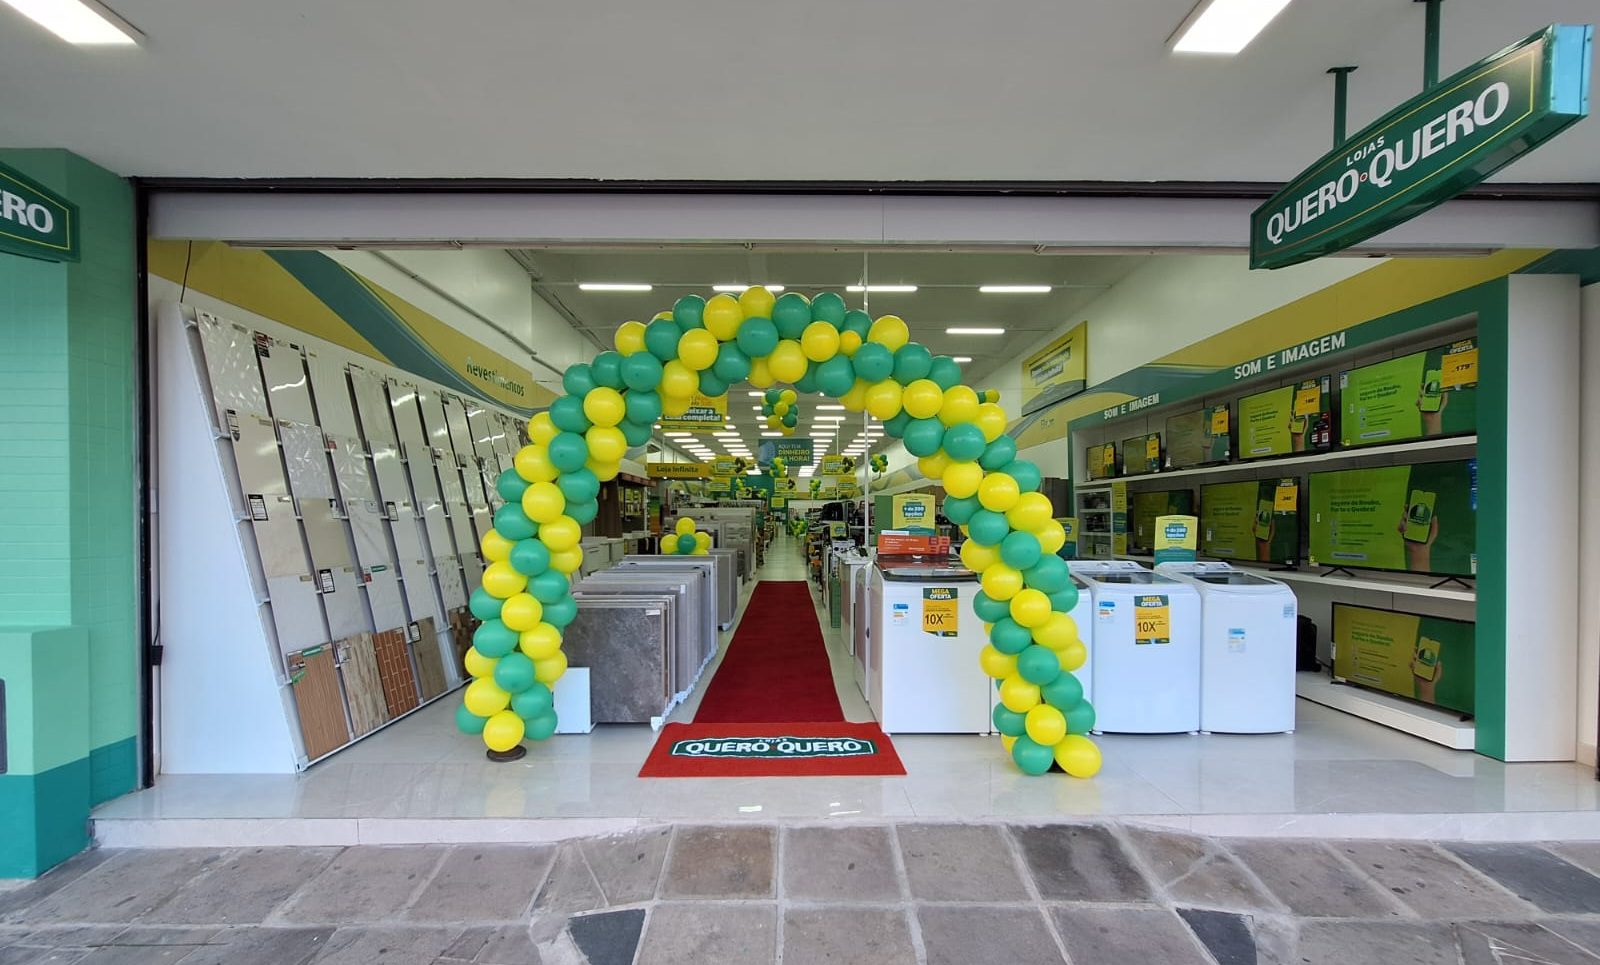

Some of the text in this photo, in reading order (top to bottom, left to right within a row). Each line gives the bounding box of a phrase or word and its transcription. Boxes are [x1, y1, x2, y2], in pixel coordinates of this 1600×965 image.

[1266, 81, 1510, 245] QUERO QUERO
[1346, 136, 1385, 167] LOJAS
[0, 189, 54, 233] RO
[1234, 331, 1346, 380] SOM E IMAGEM
[1104, 393, 1160, 420] SOM E IMAGEM
[925, 614, 944, 625] 10X
[1137, 621, 1156, 632] 10X
[685, 741, 861, 754] QUERO QUERO
